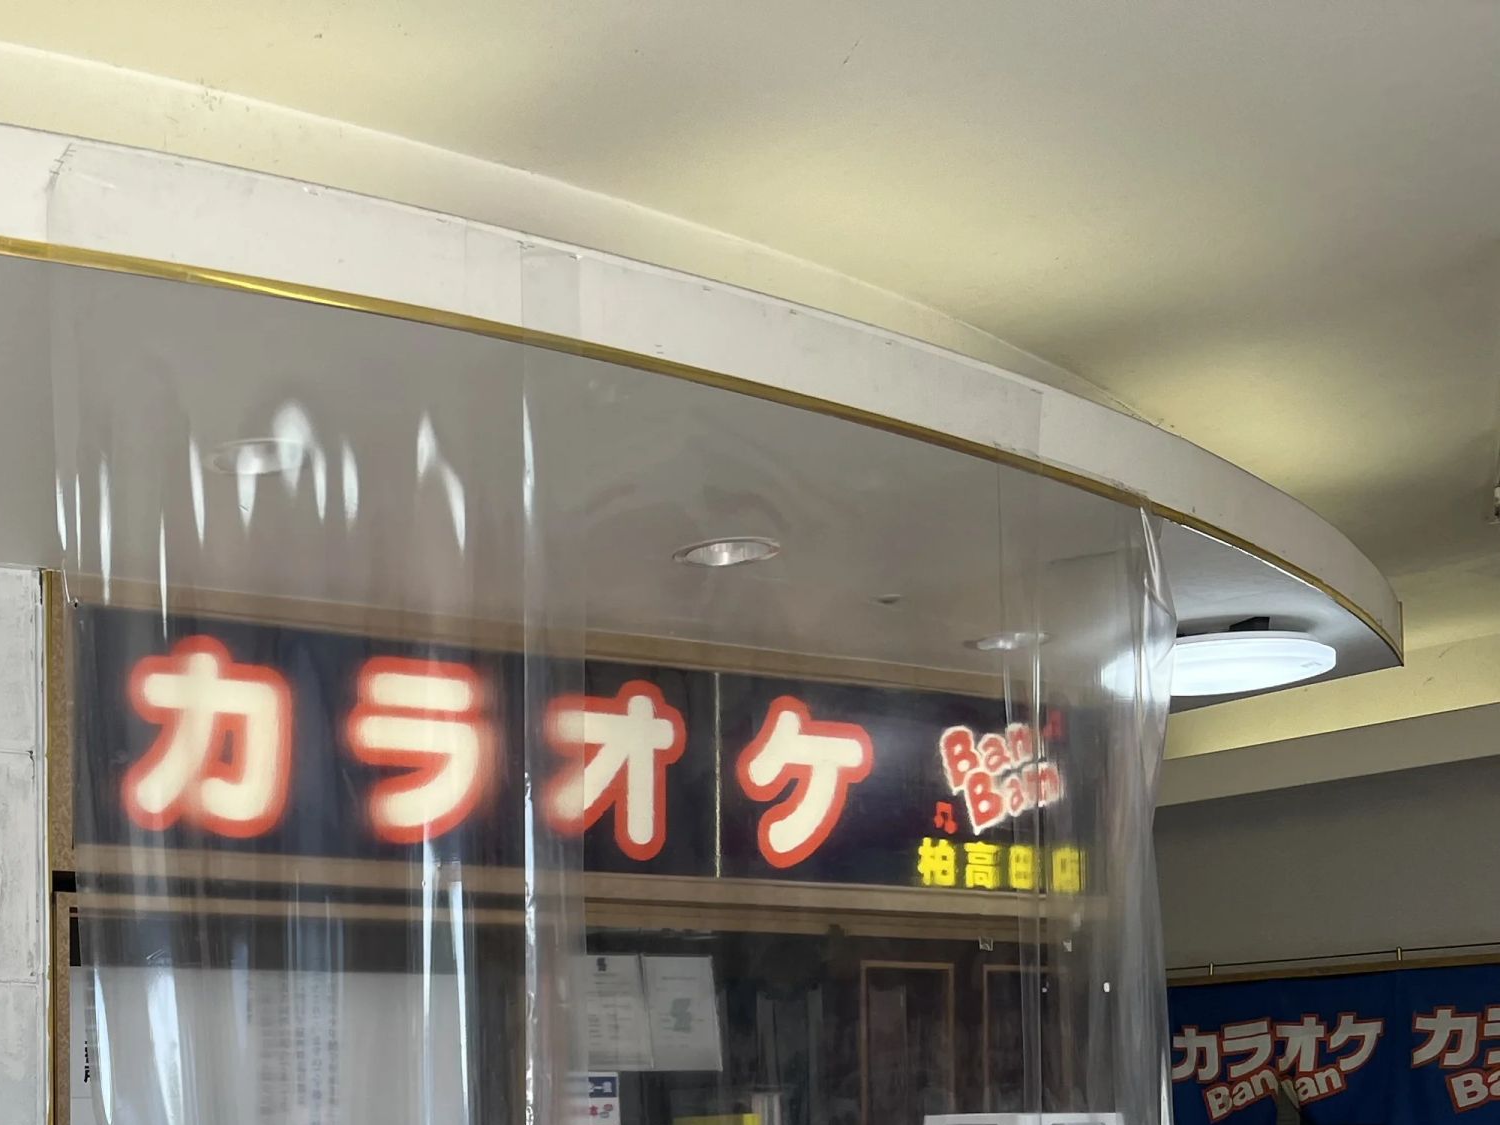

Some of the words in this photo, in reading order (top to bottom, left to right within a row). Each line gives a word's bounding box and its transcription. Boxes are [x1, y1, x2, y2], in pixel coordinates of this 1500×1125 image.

[121, 633, 875, 869] カラオケ
[940, 725, 1036, 796] Ban
[1171, 1012, 1385, 1083] カラオケ
[1411, 1006, 1500, 1069] カ
[1204, 1066, 1279, 1123] Ban
